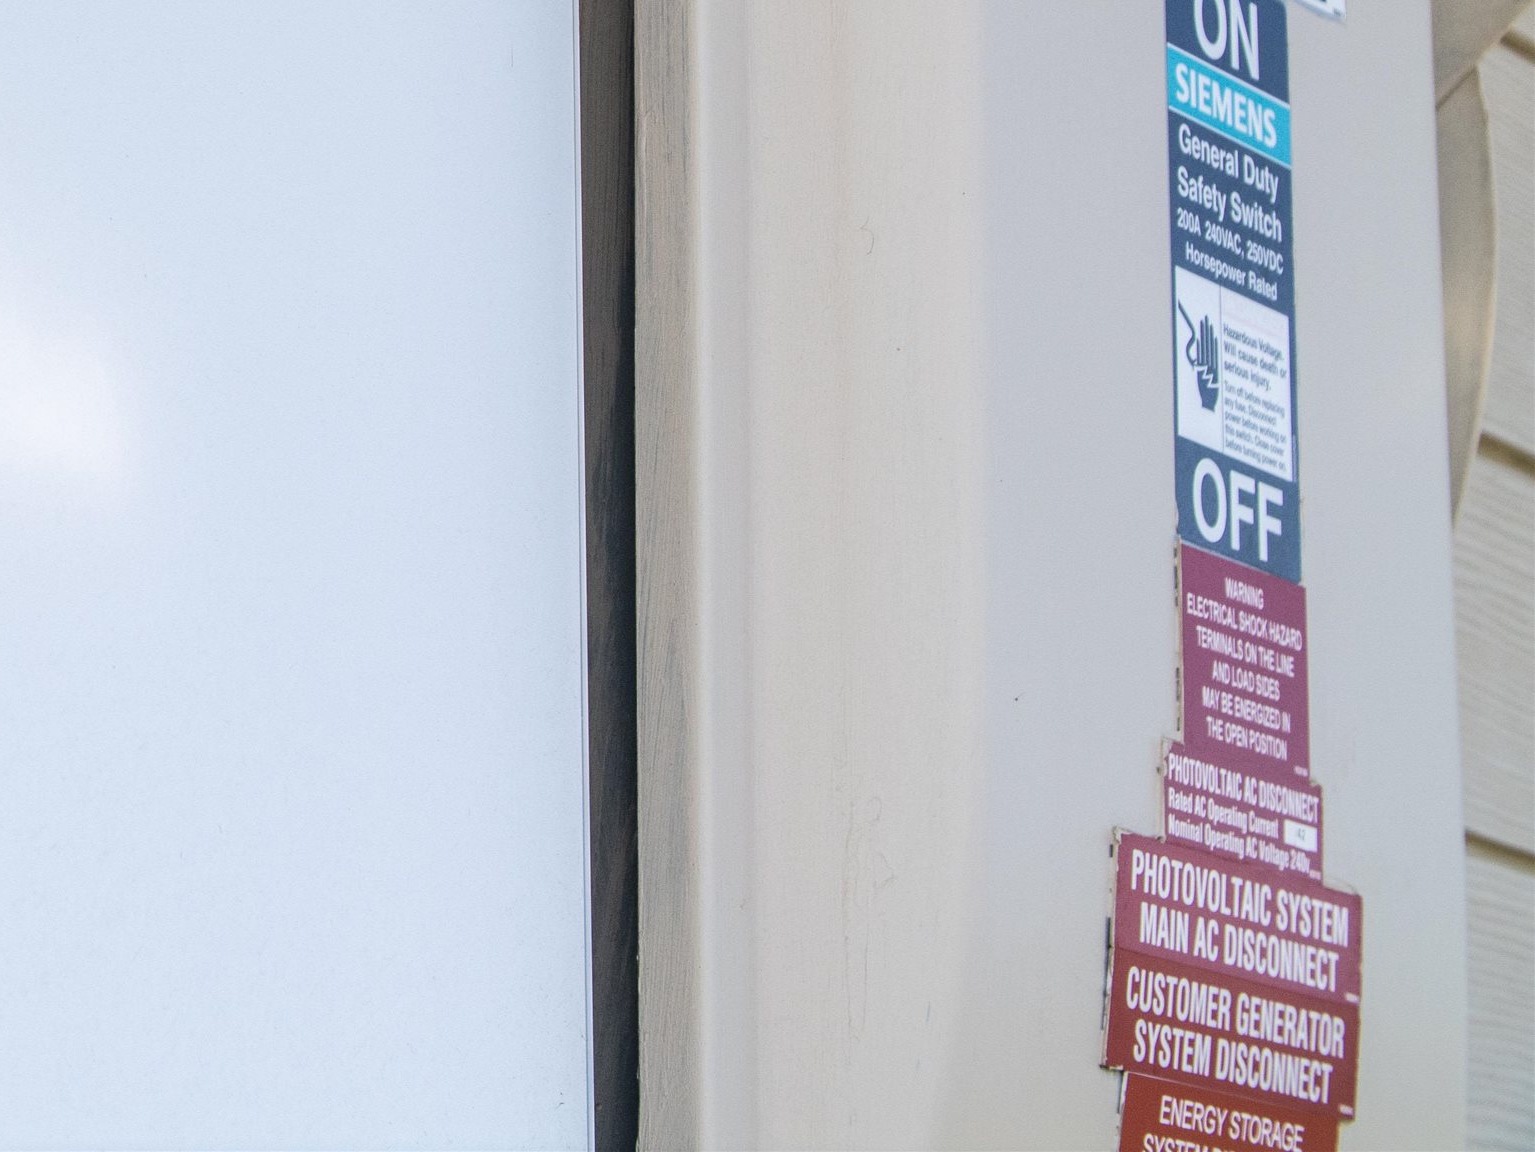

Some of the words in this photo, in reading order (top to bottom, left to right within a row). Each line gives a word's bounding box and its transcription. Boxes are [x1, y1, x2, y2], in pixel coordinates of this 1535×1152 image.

[1175, 63, 1277, 148] SIEMENS
[1178, 123, 1239, 178] General
[1244, 155, 1278, 204] Duty
[1177, 165, 1226, 222] Safety
[1230, 191, 1282, 243] Switch
[1177, 207, 1202, 236] 200A
[1205, 221, 1244, 258] 240VAC,
[1246, 239, 1284, 275] 250VDC
[1186, 242, 1246, 286] Horsepower
[1248, 270, 1278, 301] Rated
[1223, 323, 1257, 349] Hazardous
[1224, 341, 1237, 356] Will
[1238, 349, 1258, 366] cause
[1259, 359, 1278, 376] death
[1279, 368, 1287, 379] or
[1224, 360, 1249, 380] serious
[1193, 457, 1284, 562] OFF
[1186, 592, 1238, 630] ELECTRICAL
[1239, 612, 1268, 639] SHOCK
[1268, 621, 1303, 651] HAZARD
[1225, 577, 1264, 609] WARNING
[1196, 626, 1244, 661] TERMINALS
[1244, 641, 1258, 665] ON
[1258, 647, 1275, 671] THE
[1276, 652, 1295, 678] LINE
[1212, 660, 1231, 684] AND
[1231, 667, 1255, 693] LOAD
[1256, 674, 1280, 701] SIDES
[1202, 686, 1221, 710] MAY
[1221, 693, 1233, 715] BE
[1234, 696, 1281, 730] ENERGIZED
[1282, 713, 1291, 734] IN
[1206, 716, 1224, 741] THE
[1225, 722, 1248, 748] OPEN
[1249, 730, 1287, 761] POSITION
[1168, 753, 1242, 801] PHOTOVOLTAIC
[1244, 776, 1258, 806] AC
[1258, 780, 1319, 823] DISCONNECT
[1168, 787, 1193, 814] Rated
[1194, 794, 1207, 818] AC
[1207, 798, 1247, 835] Operating
[1249, 810, 1279, 839] Current
[1168, 813, 1203, 843] Nominal
[1204, 823, 1245, 860] Operating
[1245, 836, 1258, 859] AC
[1258, 841, 1290, 871] Voltage
[1131, 848, 1272, 927] PHOTOVOLTAIC
[1276, 889, 1349, 947] SYSTEM
[1139, 901, 1189, 954] MAIN
[1193, 916, 1219, 962] AC
[1223, 923, 1339, 993] DISCONNECT
[1126, 966, 1232, 1031] CUSTOMER
[1236, 992, 1346, 1059] GENERATOR
[1133, 1018, 1212, 1077] SYSTEM
[1215, 1038, 1334, 1104] DISCONNECT
[1159, 1095, 1229, 1137] ENERGY
[1229, 1110, 1305, 1152] STORAGE
